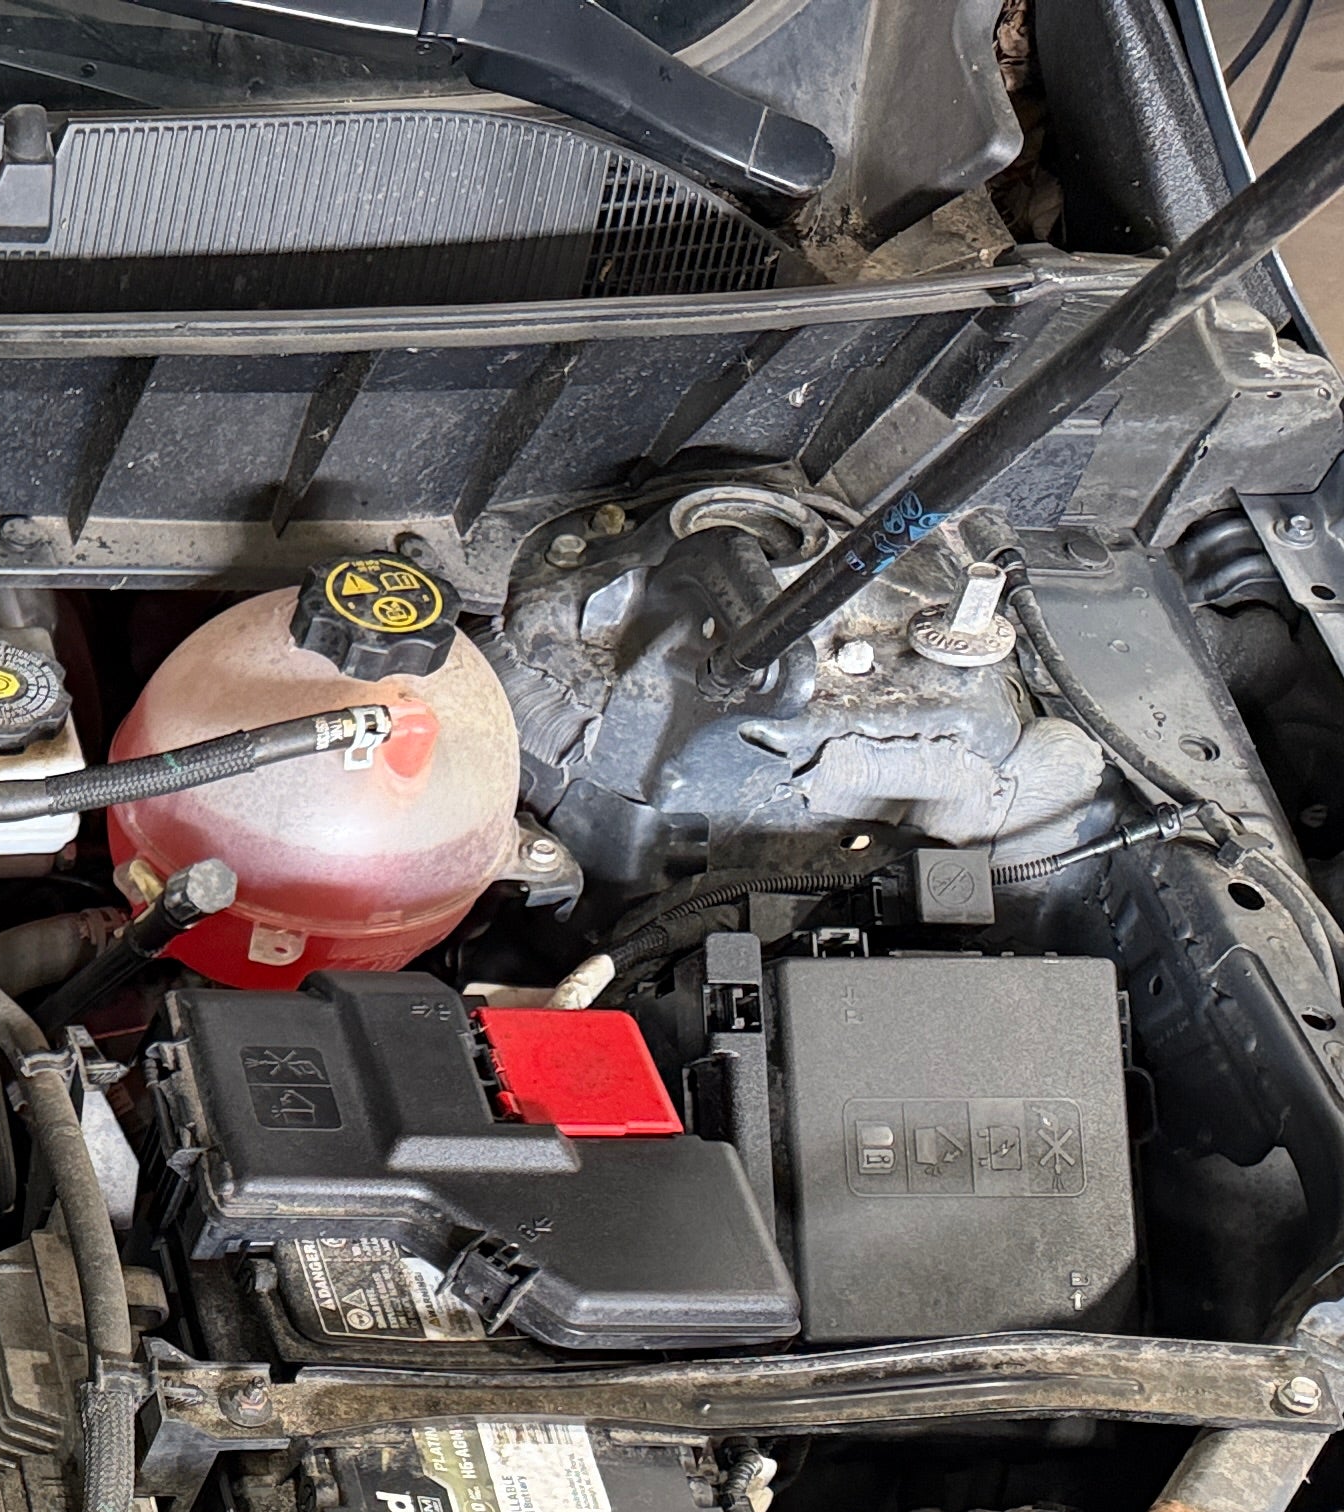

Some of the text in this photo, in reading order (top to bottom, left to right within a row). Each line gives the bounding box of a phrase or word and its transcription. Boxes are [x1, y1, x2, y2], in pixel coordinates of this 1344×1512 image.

[301, 1238, 335, 1299] DANGER!
[449, 1429, 477, 1480] H6-AGM
[516, 1475, 535, 1510] Battery
